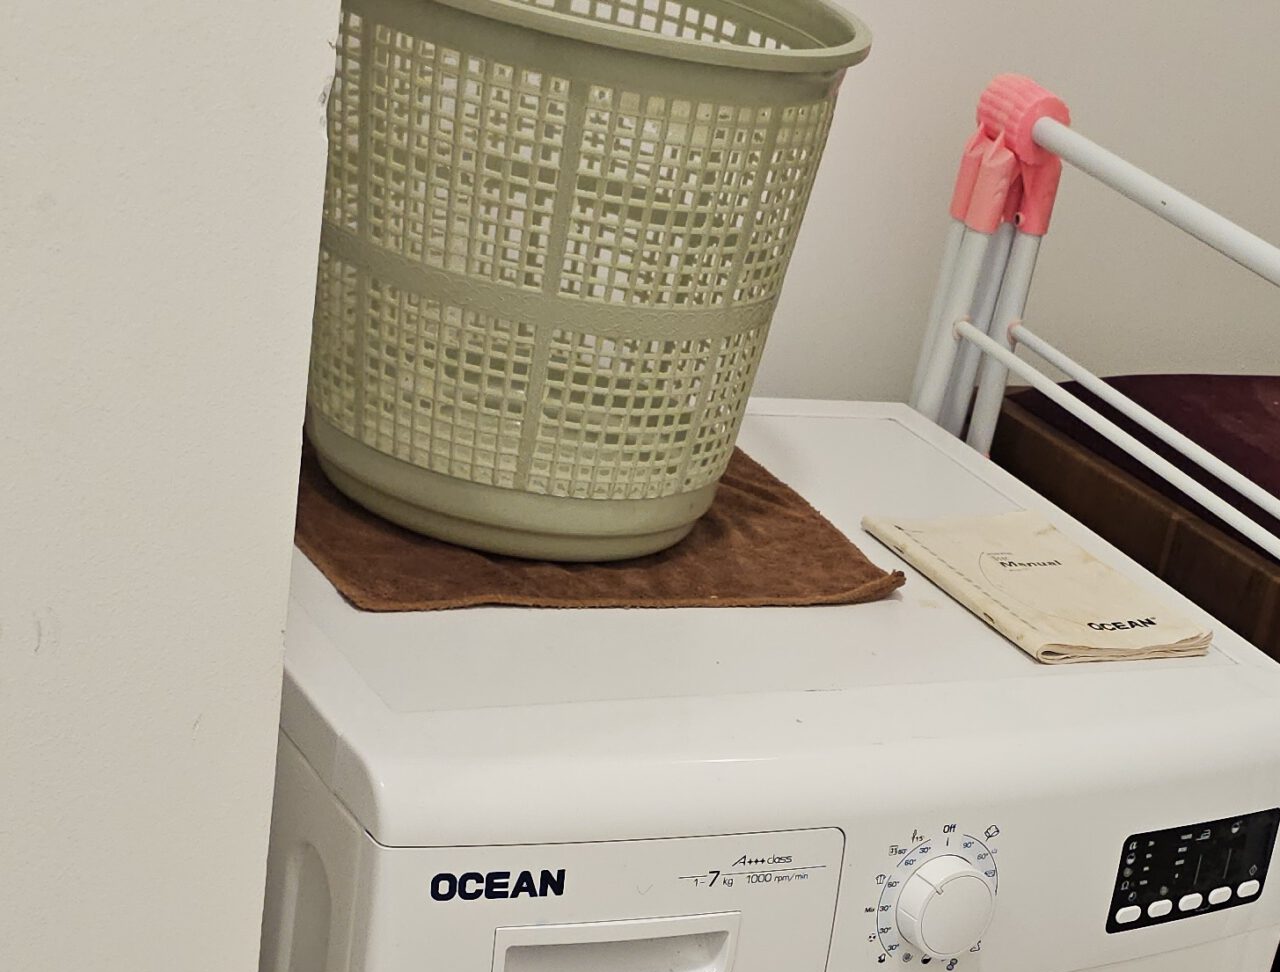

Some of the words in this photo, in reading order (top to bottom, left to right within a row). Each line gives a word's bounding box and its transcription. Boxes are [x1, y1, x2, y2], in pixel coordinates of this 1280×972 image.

[1087, 617, 1157, 631] OCEAN
[942, 824, 957, 834] Off
[430, 869, 566, 902] OCEAN
[722, 877, 734, 888] kg
[746, 873, 772, 884] 1000
